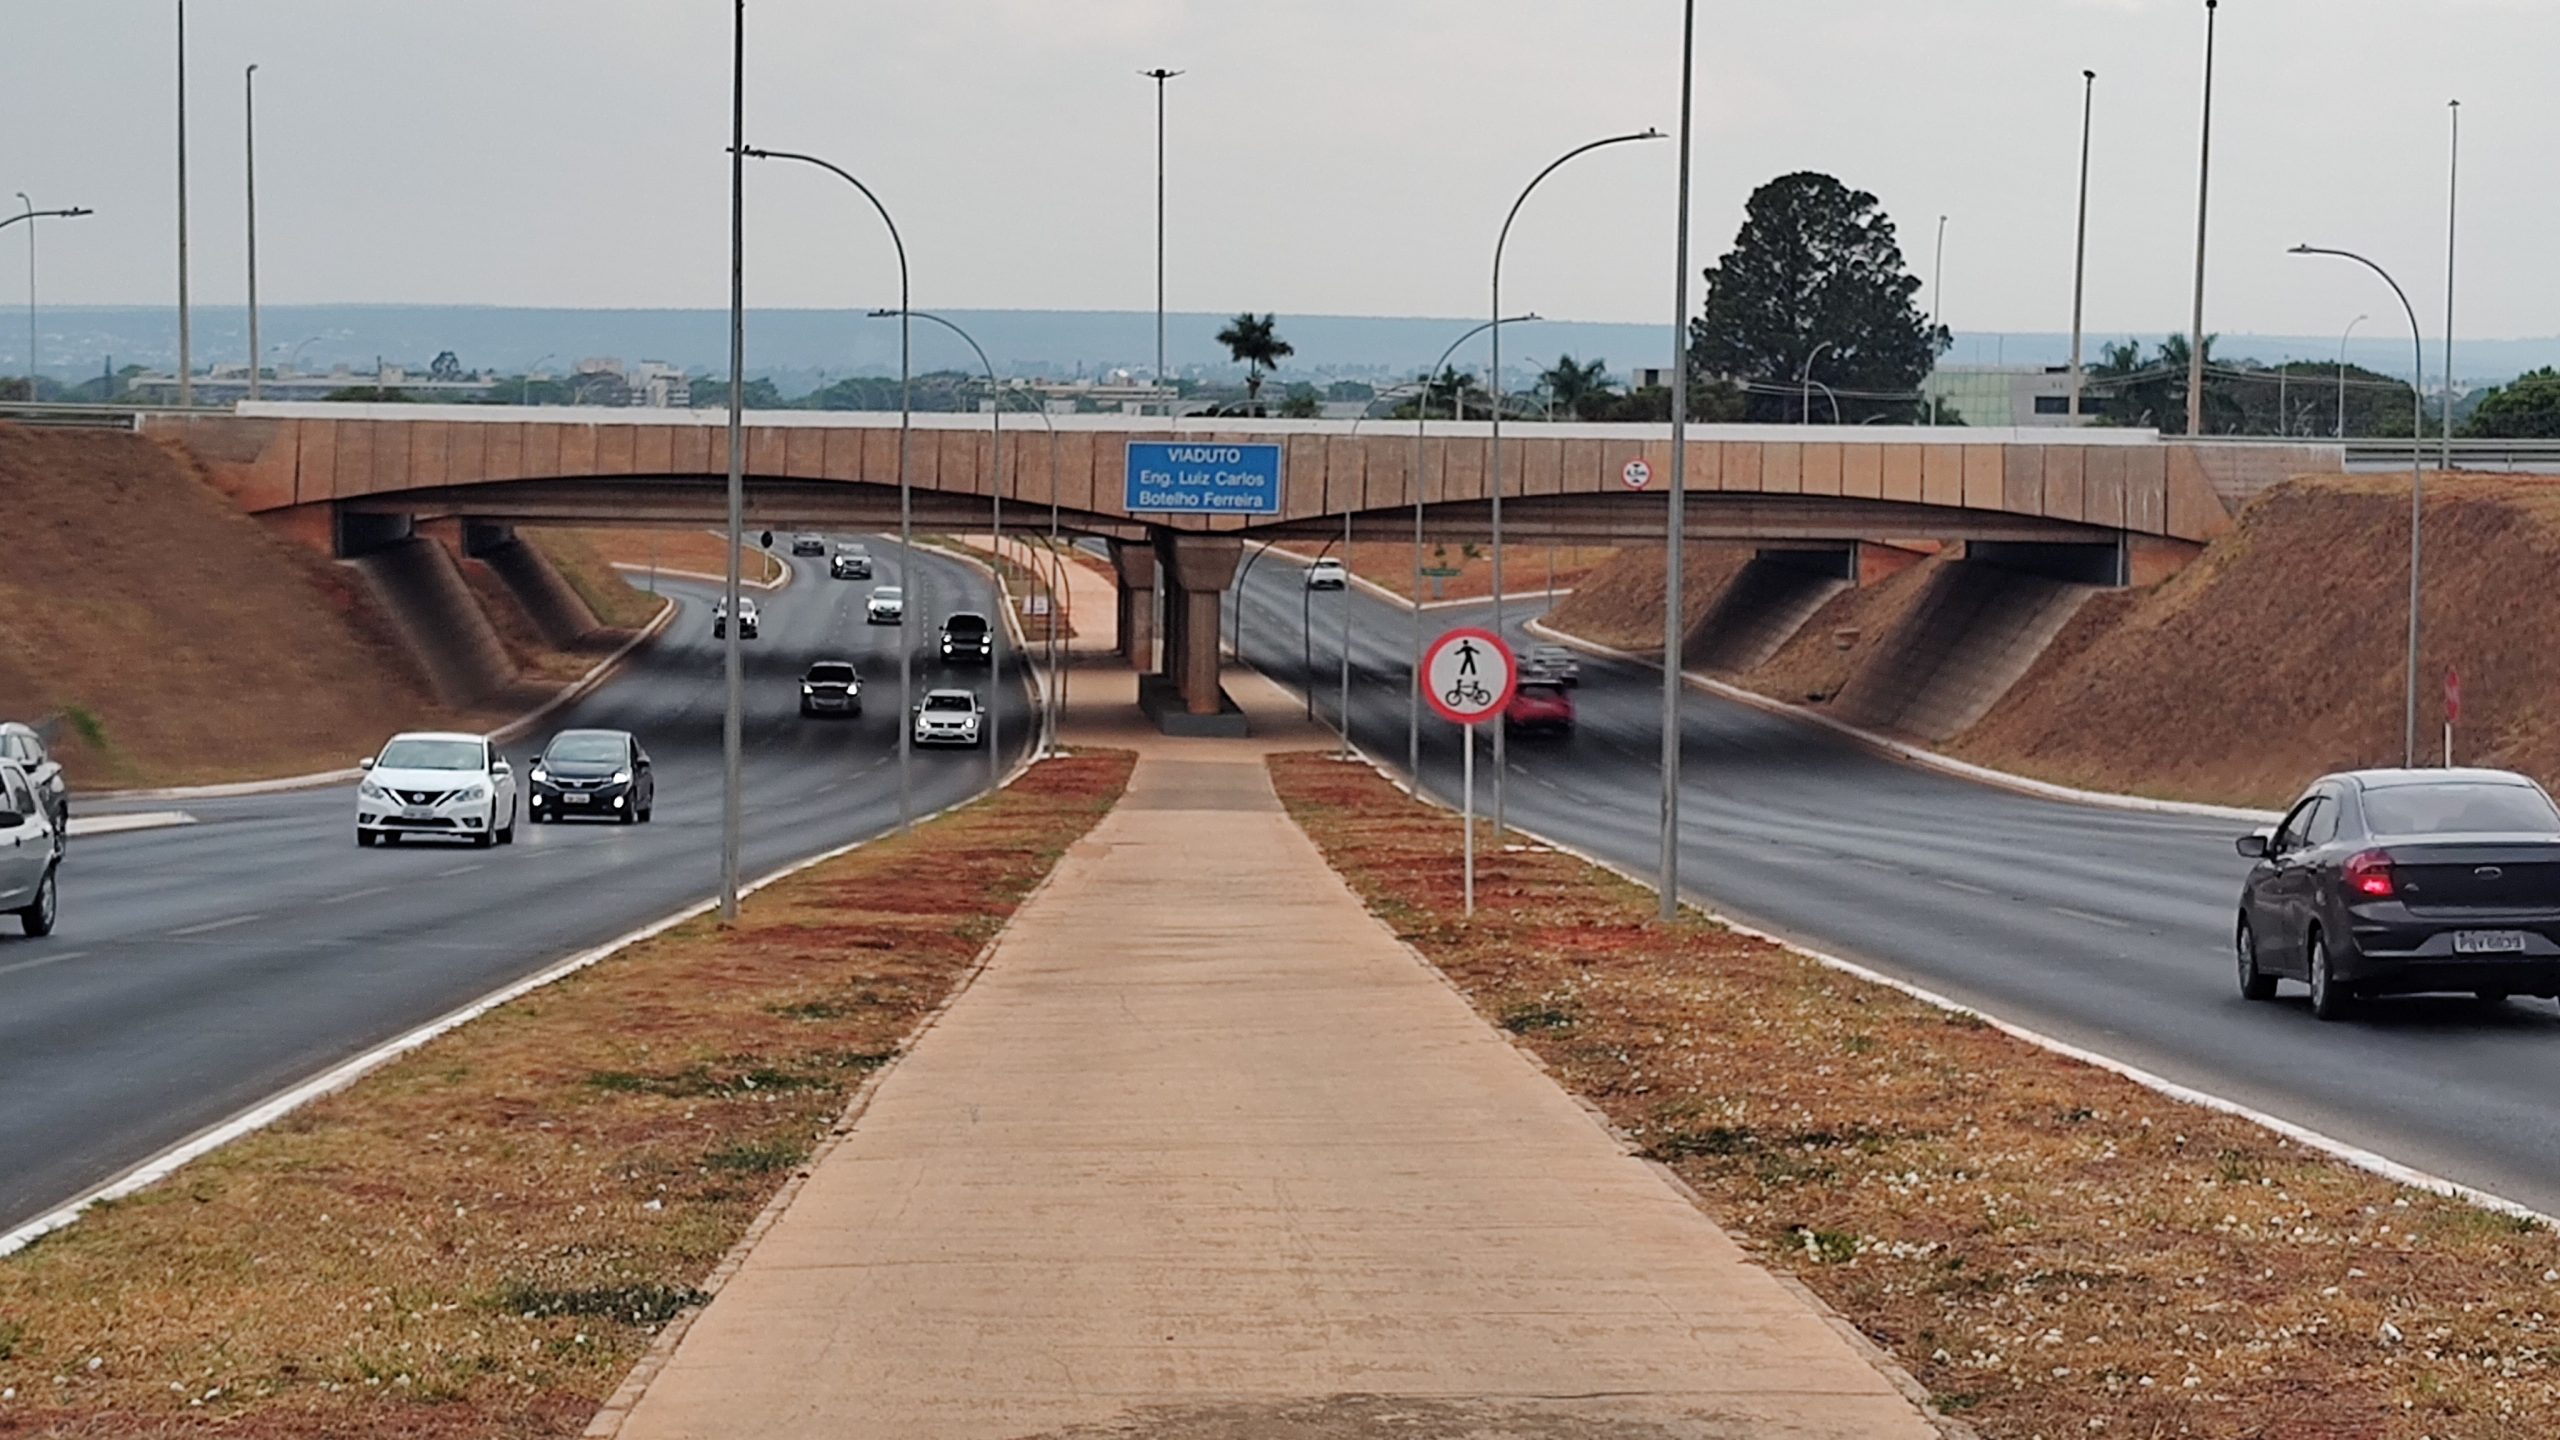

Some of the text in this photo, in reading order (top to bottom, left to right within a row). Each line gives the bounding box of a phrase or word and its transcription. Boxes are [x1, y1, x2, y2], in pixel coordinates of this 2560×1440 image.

[1168, 448, 1241, 464] VIADUTO
[1140, 470, 1265, 488] Eng. Luiz Carlos
[1139, 490, 1263, 508] Botelho Ferreira
